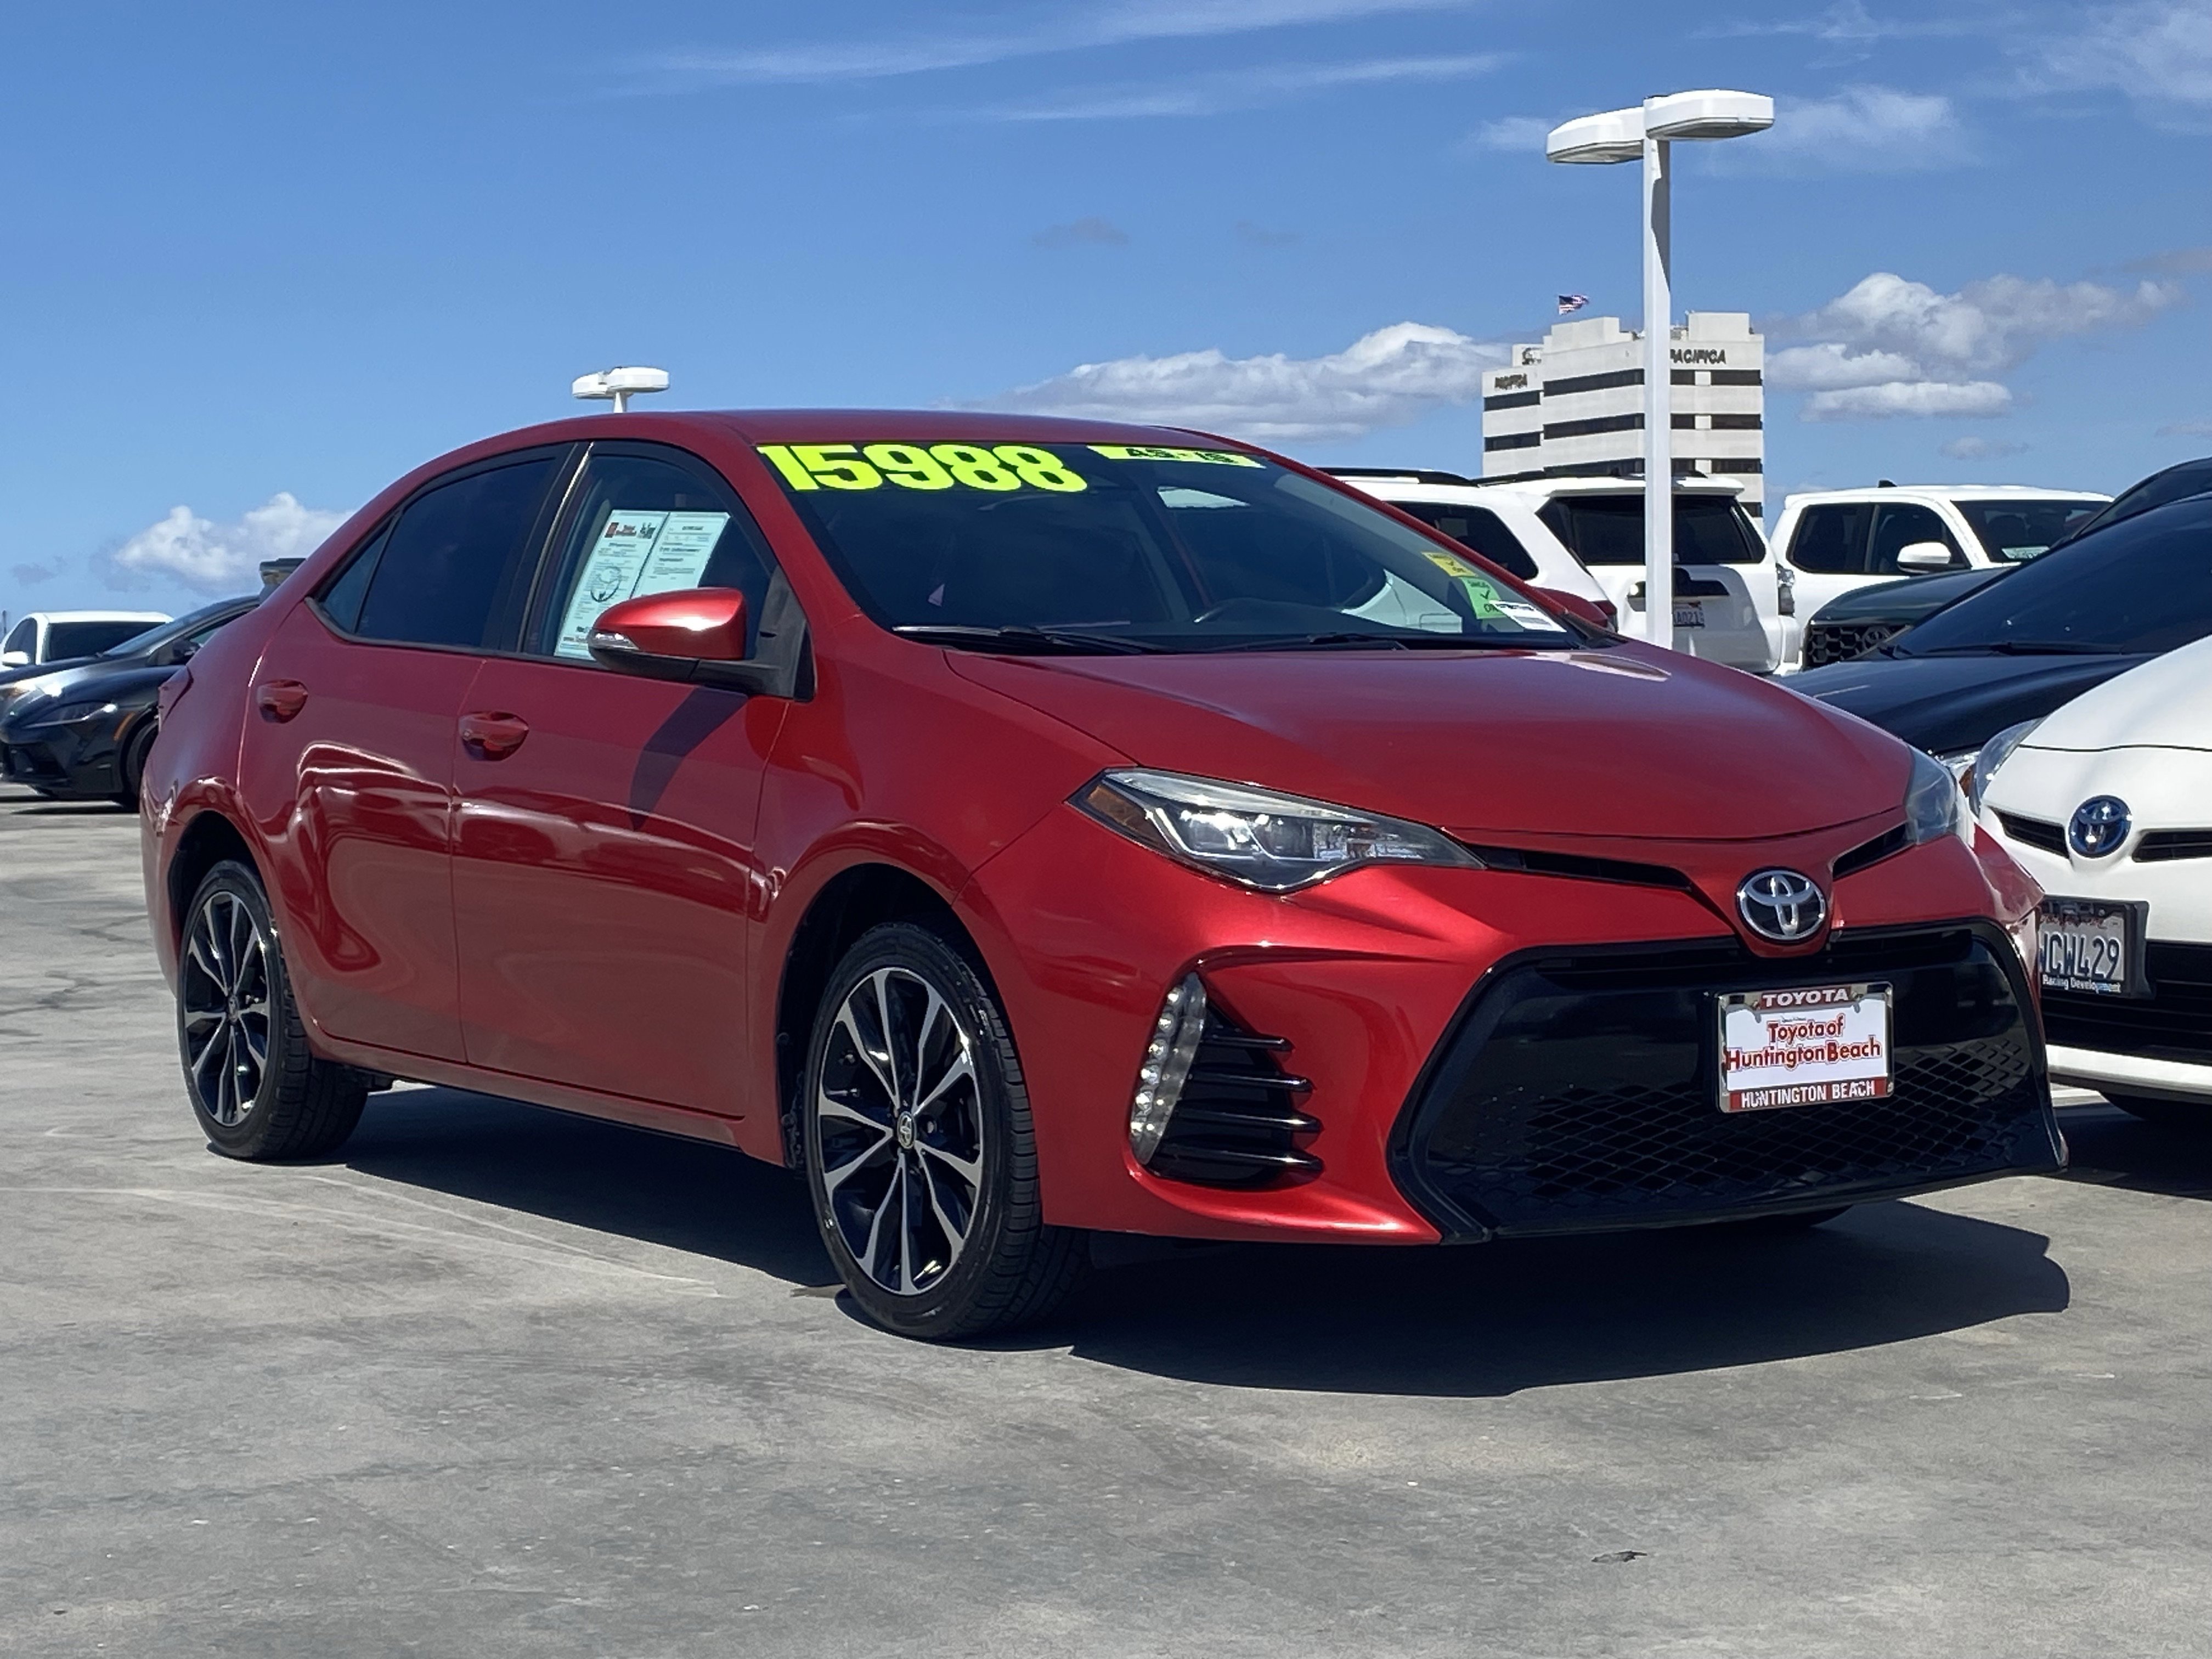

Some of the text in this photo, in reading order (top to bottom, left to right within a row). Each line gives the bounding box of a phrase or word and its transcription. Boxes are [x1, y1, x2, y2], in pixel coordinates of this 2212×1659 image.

[756, 444, 1088, 492] 15988
[1763, 989, 1849, 1007] TOYOTA
[1768, 1014, 1844, 1045] Toyota of
[1724, 1035, 1881, 1070] Huntington Beach
[1741, 1081, 1875, 1108] HUNTINGTON BEACH
